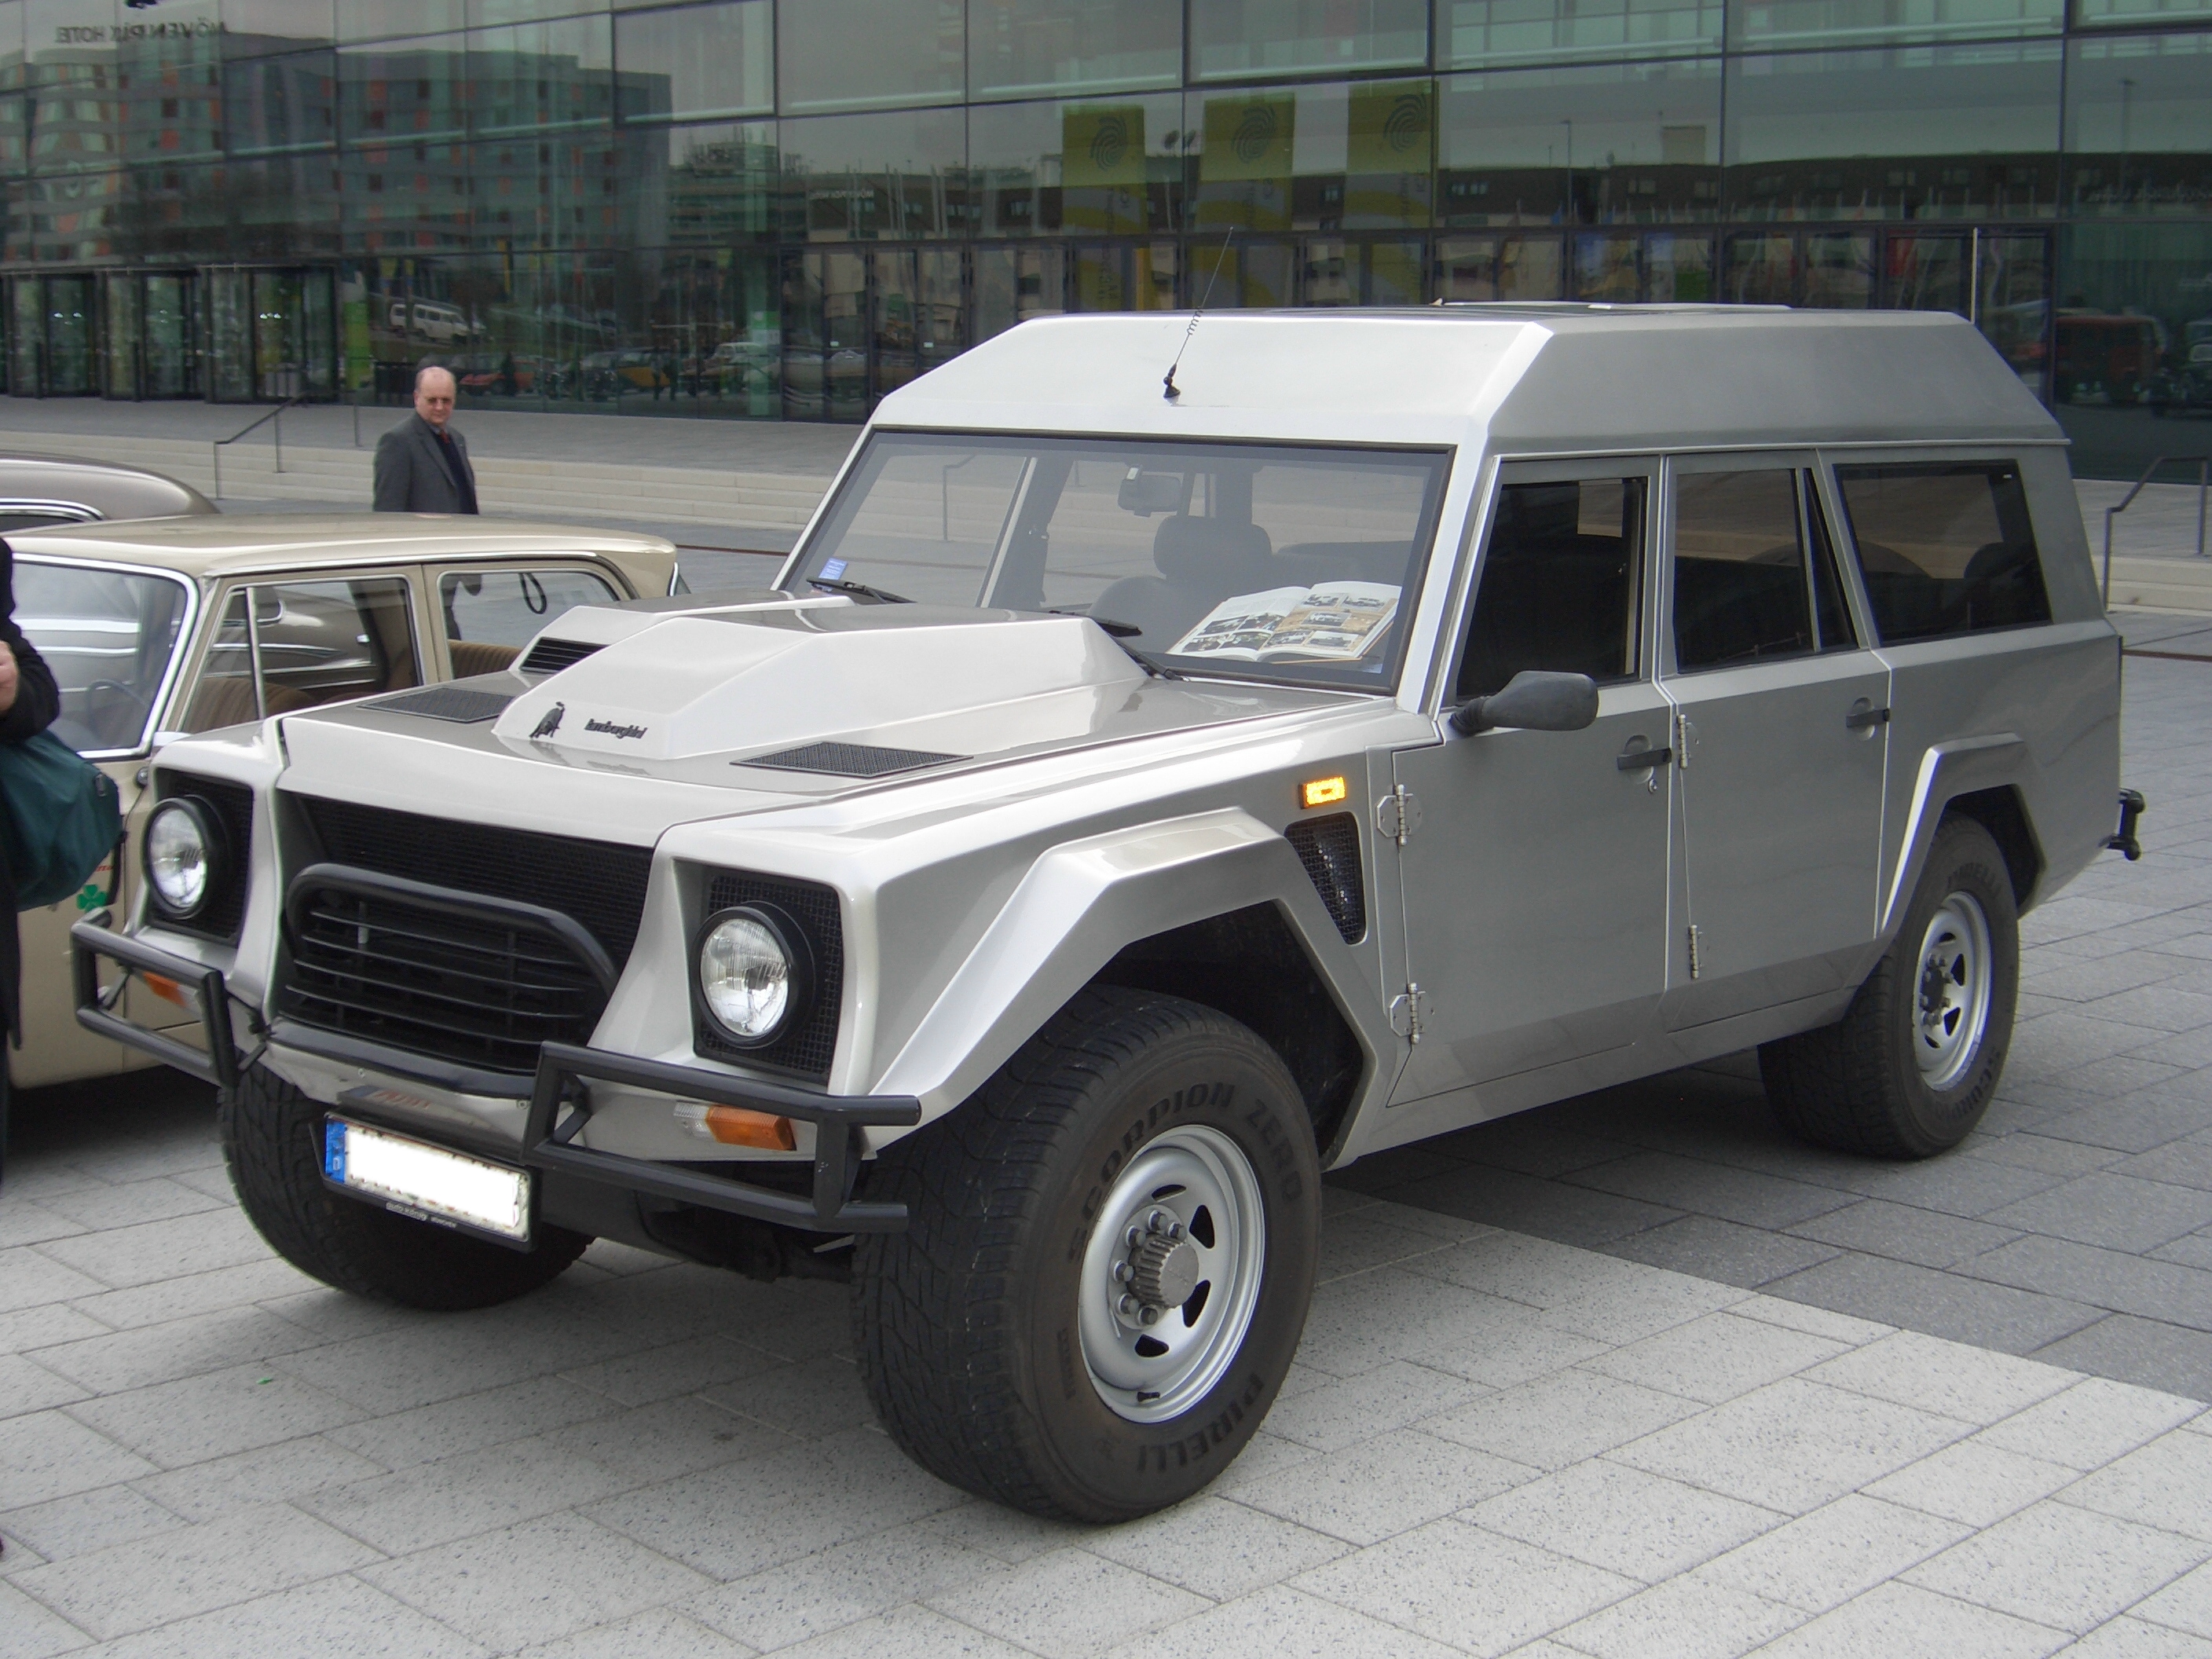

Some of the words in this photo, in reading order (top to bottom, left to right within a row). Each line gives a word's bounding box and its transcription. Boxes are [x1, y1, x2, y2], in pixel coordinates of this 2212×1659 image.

[1068, 1082, 1236, 1262] SCORPION
[1246, 1099, 1303, 1202] ZERO
[1137, 1373, 1265, 1473] PIRELLI
